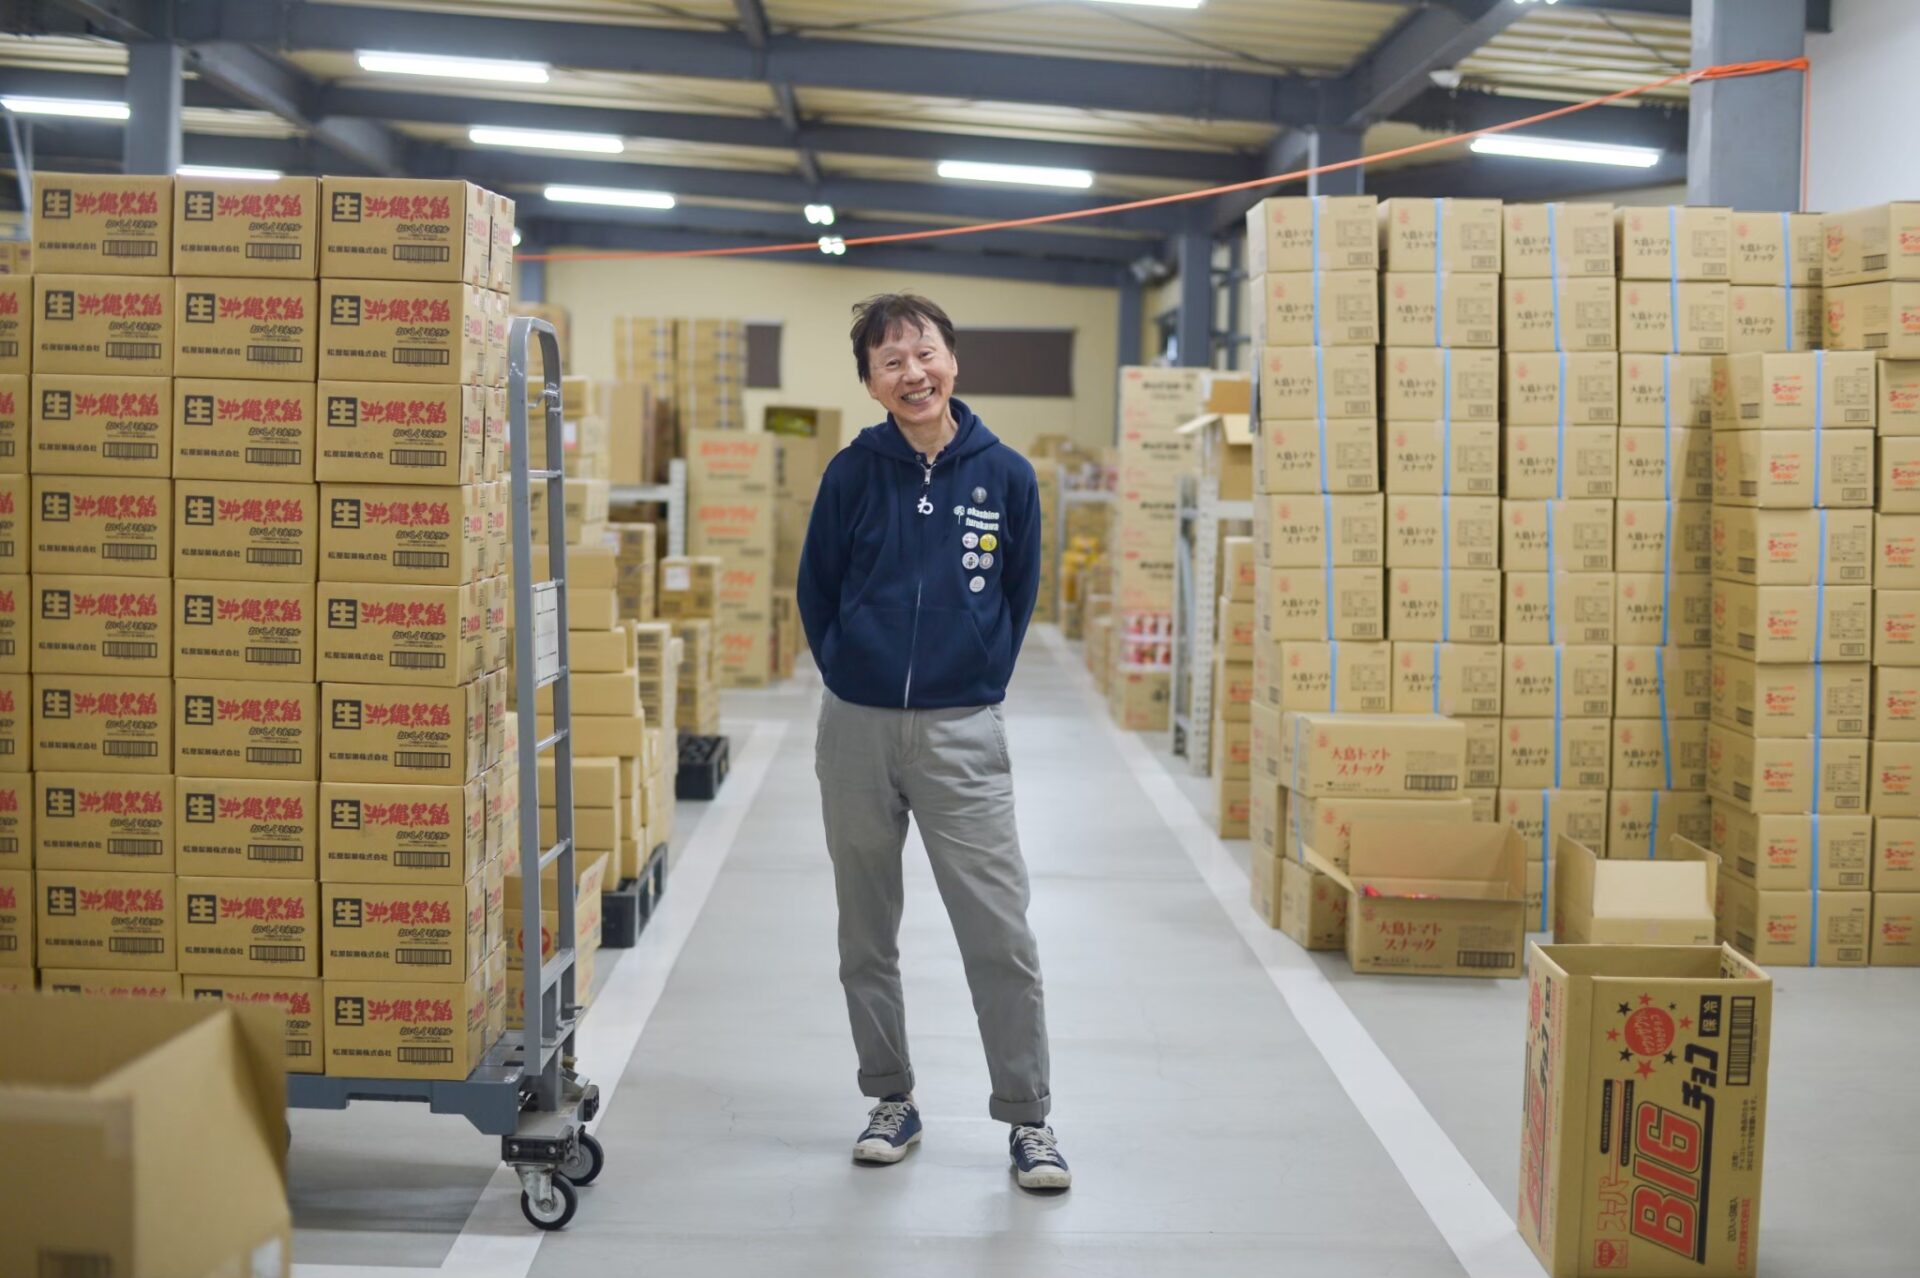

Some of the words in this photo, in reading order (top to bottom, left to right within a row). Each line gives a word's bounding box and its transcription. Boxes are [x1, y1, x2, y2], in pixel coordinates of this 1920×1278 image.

[45, 190, 71, 217] 生
[187, 192, 213, 220] 生
[334, 194, 360, 221] 生
[47, 291, 73, 319] 生
[188, 295, 215, 322] 生
[333, 297, 360, 324] 生
[44, 391, 70, 419] 生
[186, 397, 213, 424] 生
[330, 398, 356, 426] 生
[44, 493, 70, 520] 生
[187, 497, 214, 524] 生
[333, 500, 360, 527] 生
[44, 591, 70, 618] 生
[187, 596, 213, 623] 生
[330, 600, 356, 628] 生
[45, 690, 71, 717] 生
[187, 696, 213, 724] 生
[334, 700, 360, 728] 生
[1332, 746, 1390, 761] 大島トマト
[1337, 763, 1384, 776] スナック
[48, 788, 74, 816] 生
[188, 794, 214, 822] 生
[334, 800, 360, 828] 生
[50, 887, 76, 914] 生
[190, 895, 216, 922] 生
[335, 898, 362, 926] 生
[1377, 922, 1442, 935] 大島トマト
[1384, 937, 1436, 951] スナック
[338, 997, 364, 1024] 生
[1702, 1000, 1718, 1032] 保冷
[1629, 1100, 1702, 1261] BIG
[1681, 1043, 1719, 1111] チョコ
